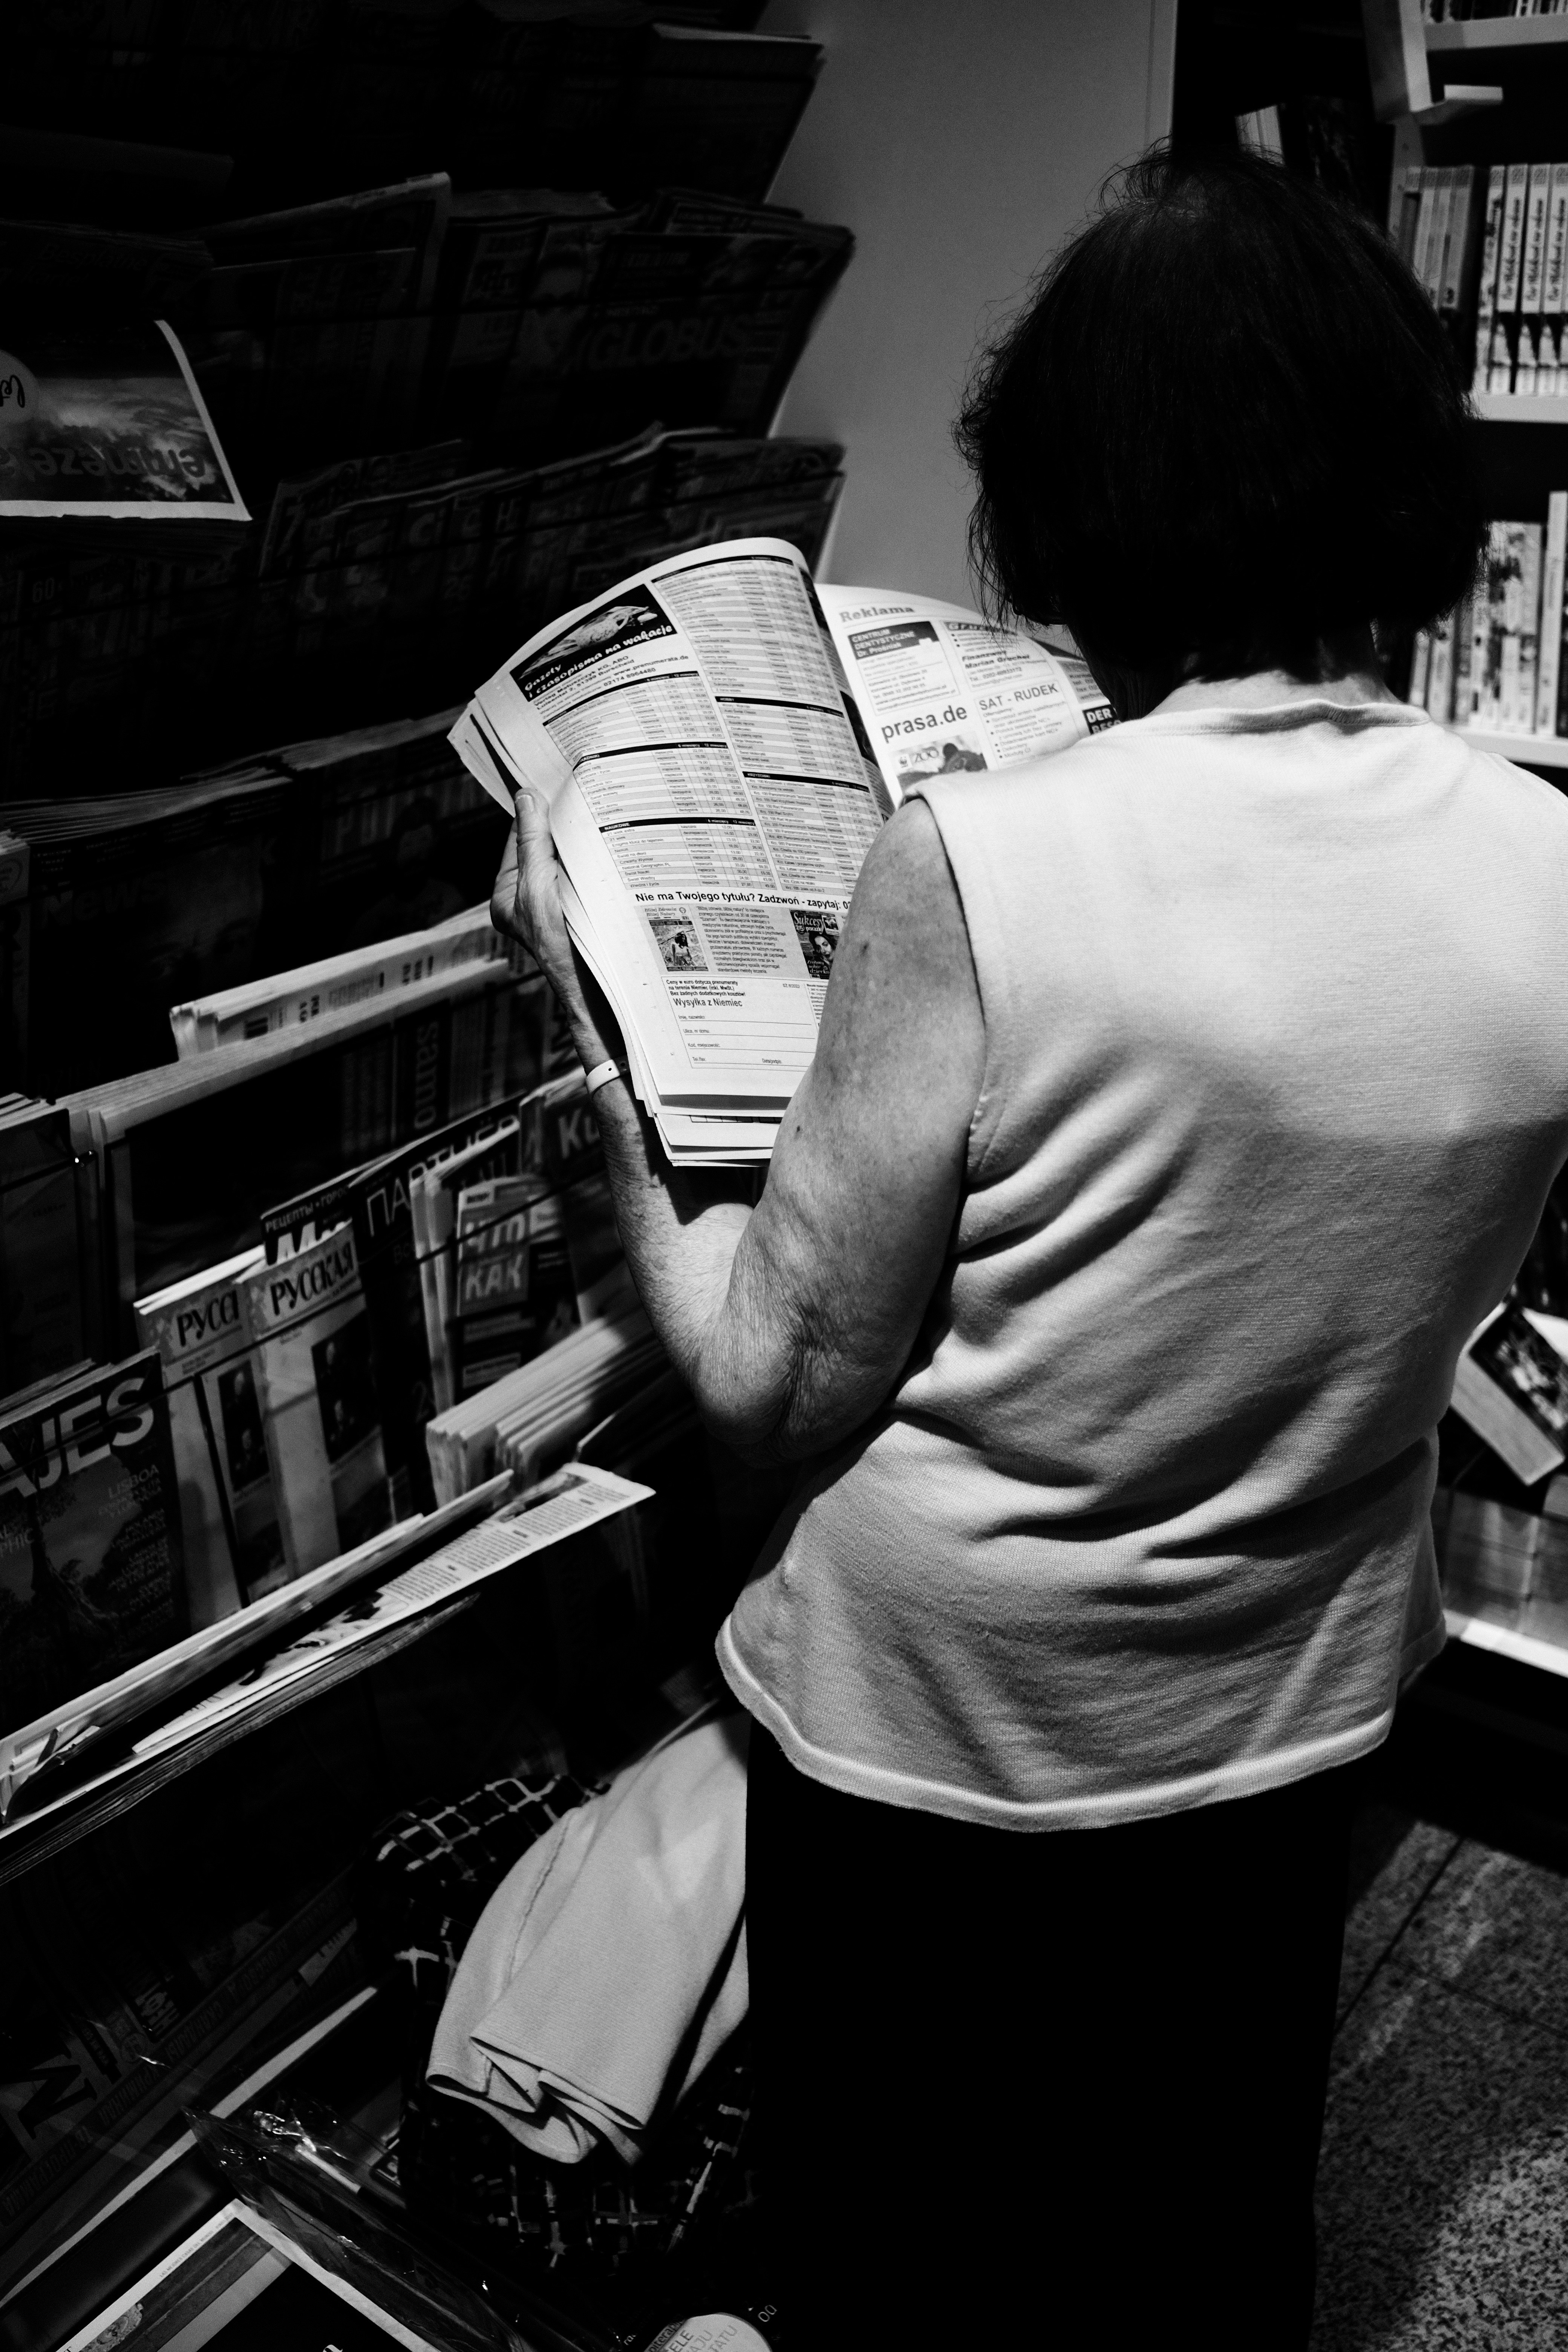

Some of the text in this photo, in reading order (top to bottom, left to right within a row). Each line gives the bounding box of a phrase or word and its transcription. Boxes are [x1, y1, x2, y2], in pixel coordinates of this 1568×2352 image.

[590, 315, 748, 371] GLOBUS
[839, 606, 915, 623] Reklama
[853, 629, 890, 642] CENTRUM
[855, 631, 915, 649] DENTYSTYCZNE
[536, 652, 602, 694] czasopisma
[606, 643, 621, 654] na
[623, 625, 672, 646] wakacje
[614, 655, 689, 676] www.prenumerata.de
[965, 659, 994, 669] Marian
[524, 665, 562, 691] Gazety
[577, 675, 597, 689] 51399
[599, 660, 634, 676] Burscheid
[604, 677, 624, 686] 02174
[534, 694, 556, 706] Verlag
[978, 696, 1003, 710] SAT
[1014, 683, 1058, 702] RUDEK
[881, 705, 968, 744] prasa.de
[1086, 708, 1112, 723] DER
[38, 869, 163, 929] News
[636, 893, 654, 902] Nie
[676, 891, 719, 903] Twojego
[722, 892, 755, 902] tytułu?
[759, 894, 799, 905] Zadzwoń
[807, 898, 841, 910] zapytaj:
[793, 912, 825, 933] Sukcesy
[673, 998, 706, 1008] Wysyłka
[265, 1200, 317, 1233] РЕЦЕПТЫ
[270, 1240, 355, 1316] РУССКАЯ
[466, 1253, 526, 1300] КАК
[107, 1462, 159, 1499] LISBOA
[96, 2063, 160, 2127] КРИМИНАЛ
[163, 2001, 226, 2063] СКАНДАЛЫ
[665, 2329, 694, 2352] ELE
